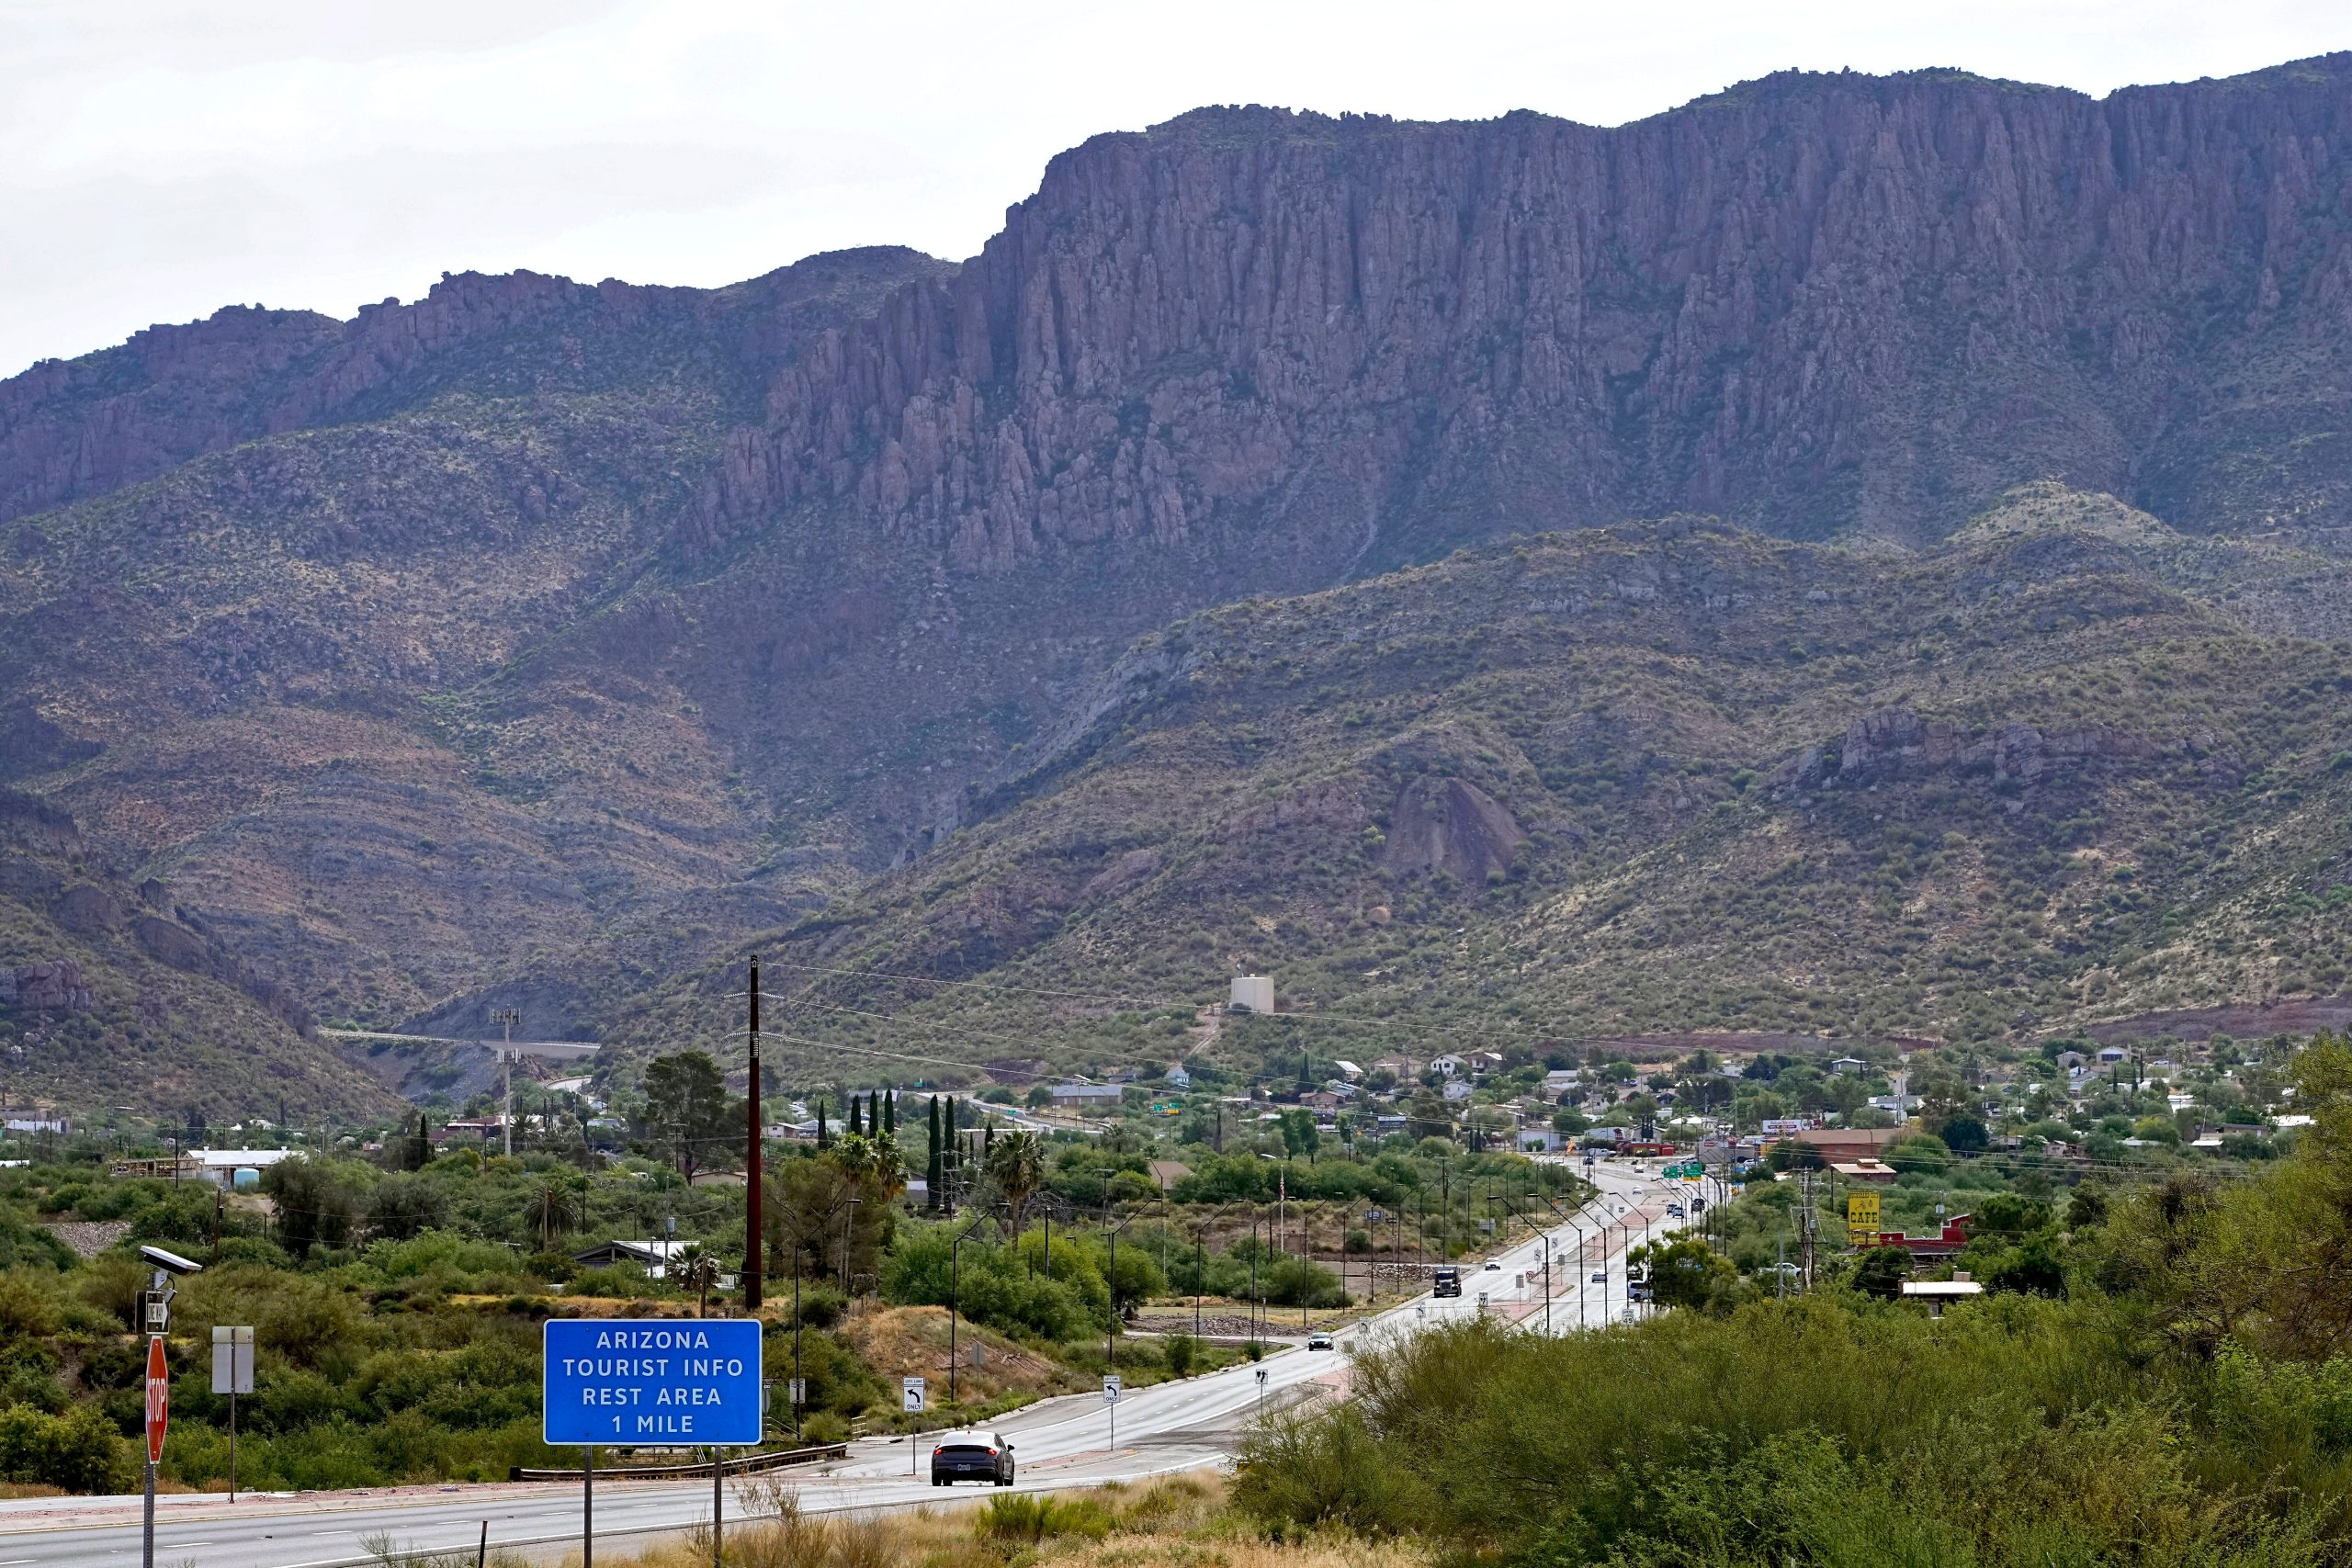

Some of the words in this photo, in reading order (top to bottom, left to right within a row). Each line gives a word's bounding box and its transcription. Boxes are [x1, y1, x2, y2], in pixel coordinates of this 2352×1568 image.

[1850, 1212, 1878, 1224] CAFE
[595, 1331, 709, 1348] ARIZONA
[563, 1359, 669, 1376] TOURIST
[684, 1359, 743, 1376] INFO
[148, 1378, 166, 1423] STOP
[583, 1388, 642, 1404] REST
[656, 1388, 722, 1404] AREA
[612, 1416, 620, 1432] 1
[638, 1416, 693, 1432] MILE
